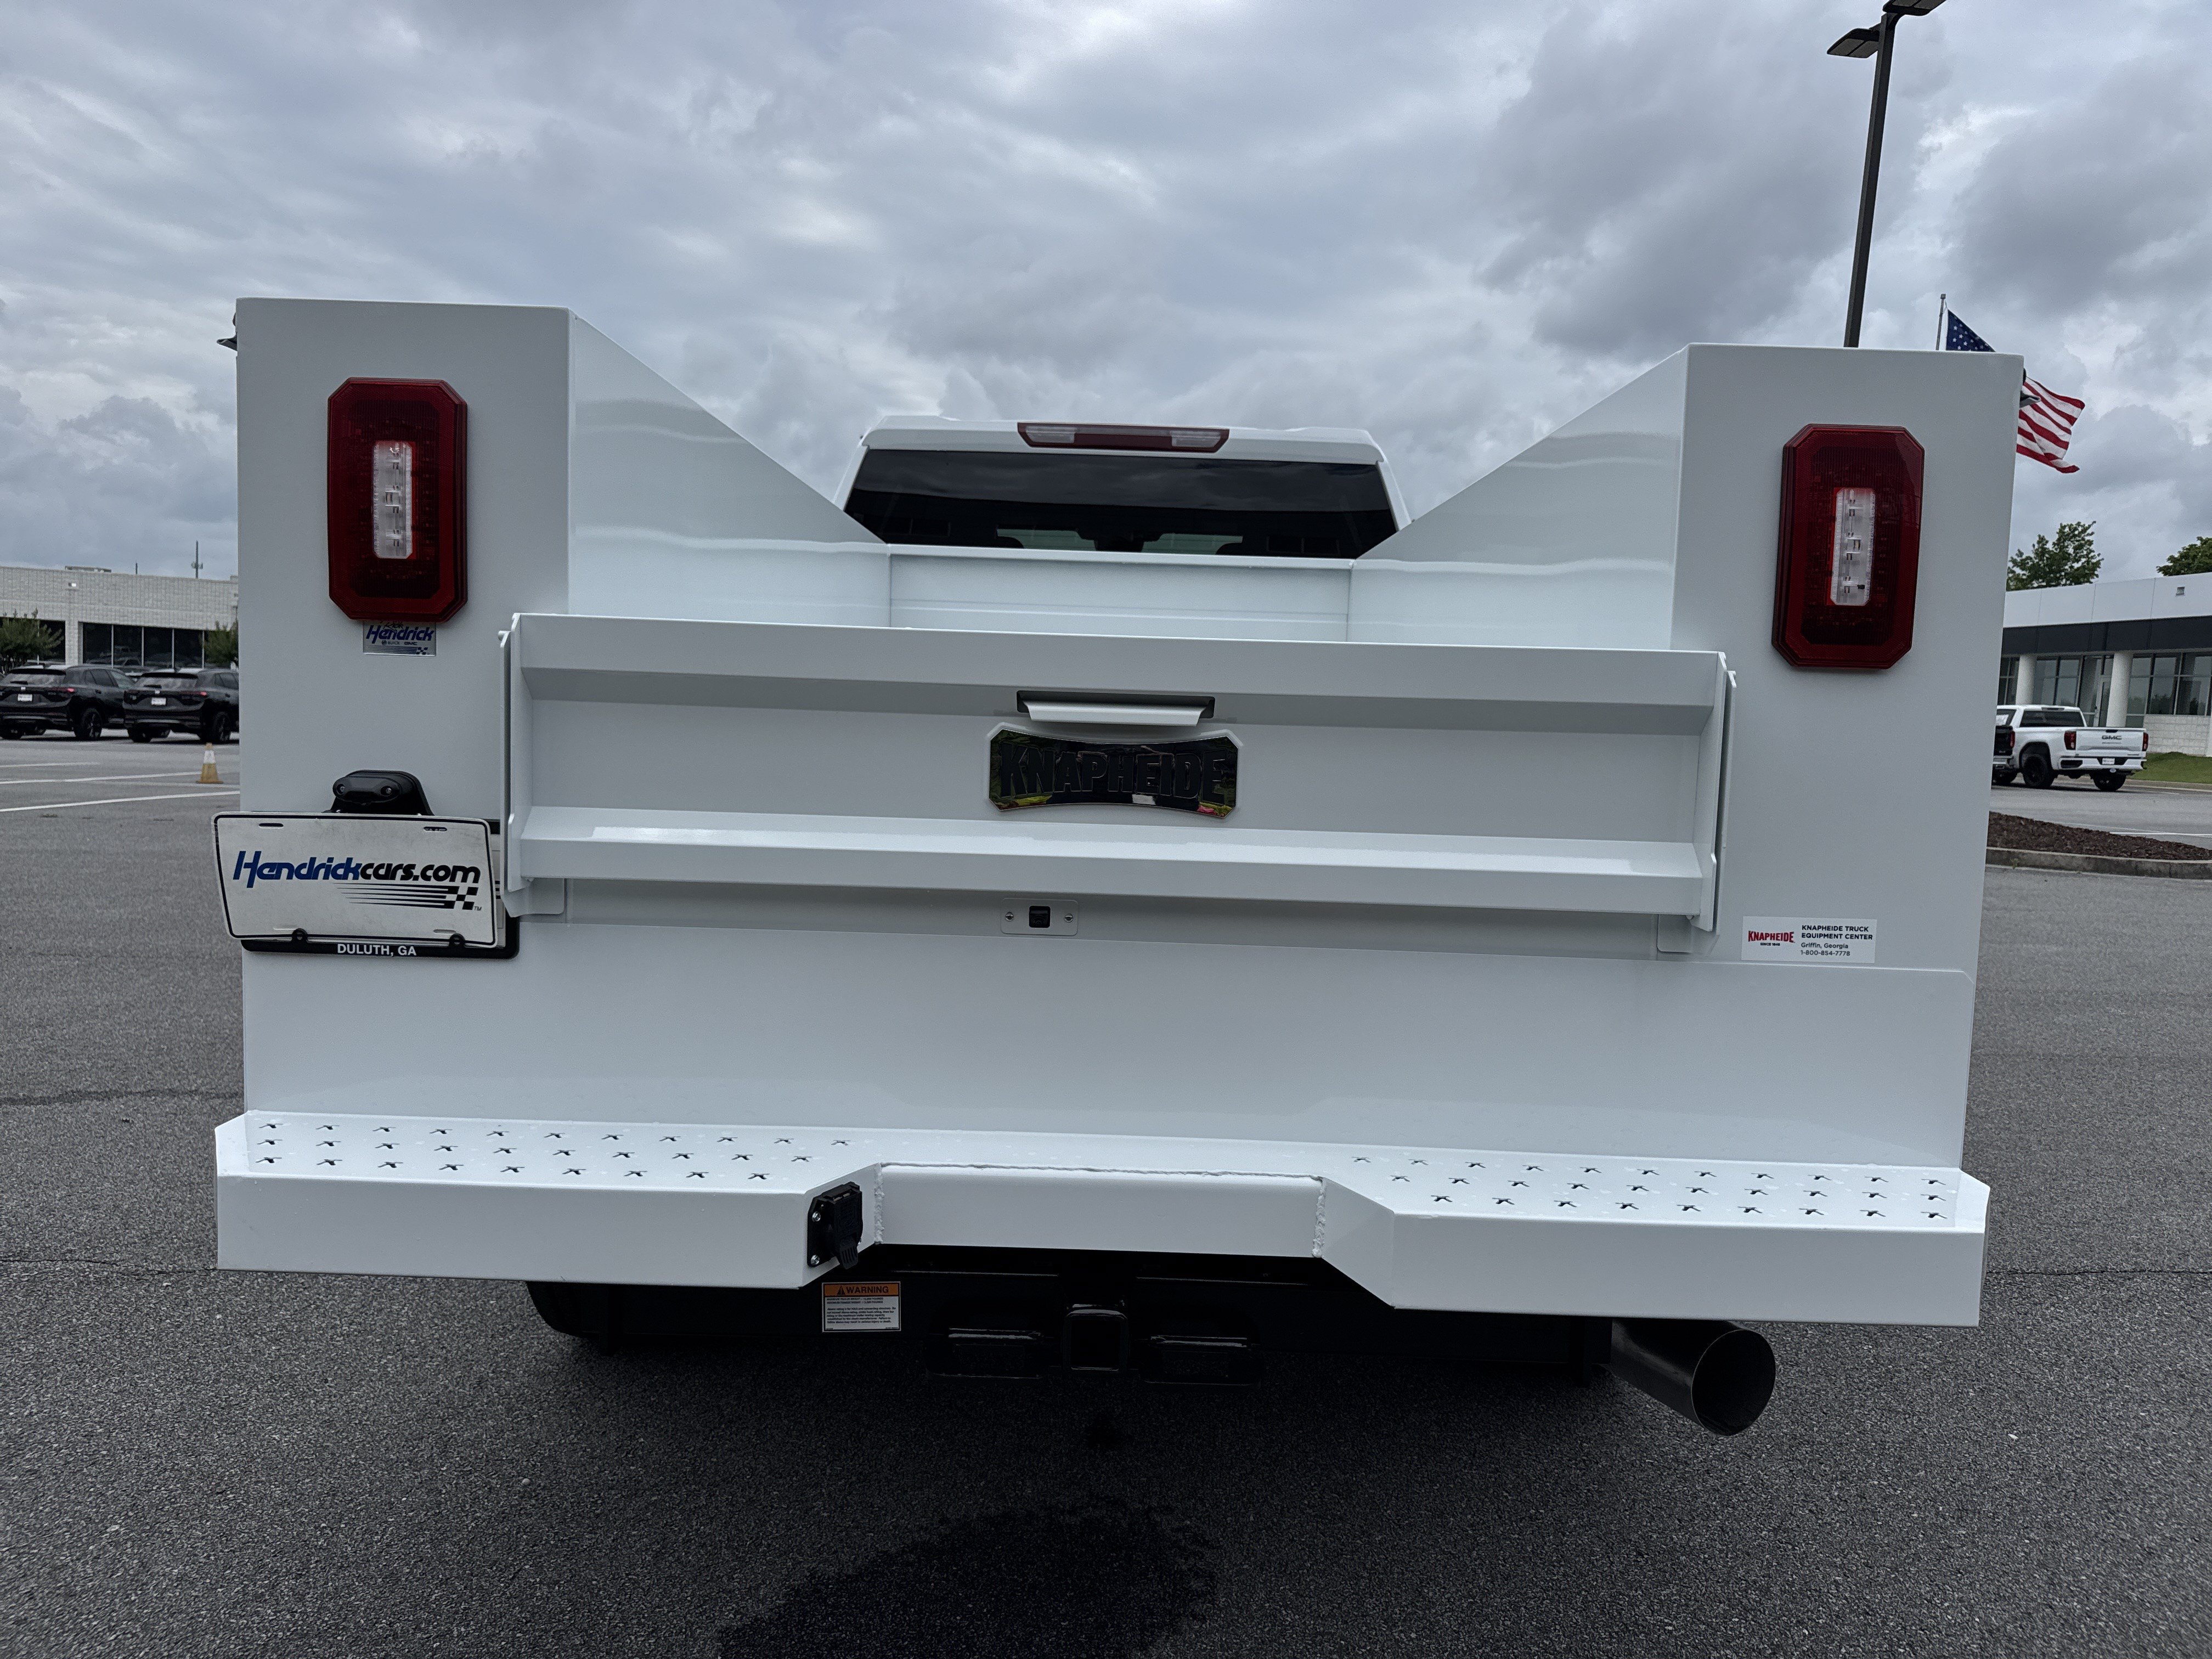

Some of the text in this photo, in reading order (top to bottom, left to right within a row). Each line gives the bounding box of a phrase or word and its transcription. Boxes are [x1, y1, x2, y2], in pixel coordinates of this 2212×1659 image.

[366, 625, 435, 644] Hendrick
[1001, 742, 1228, 805] KNAPHEIDE
[233, 850, 481, 888] Hendrickcars.com
[1748, 930, 1795, 943] KNAPHEIDE
[337, 943, 417, 958] DULUTH, GA
